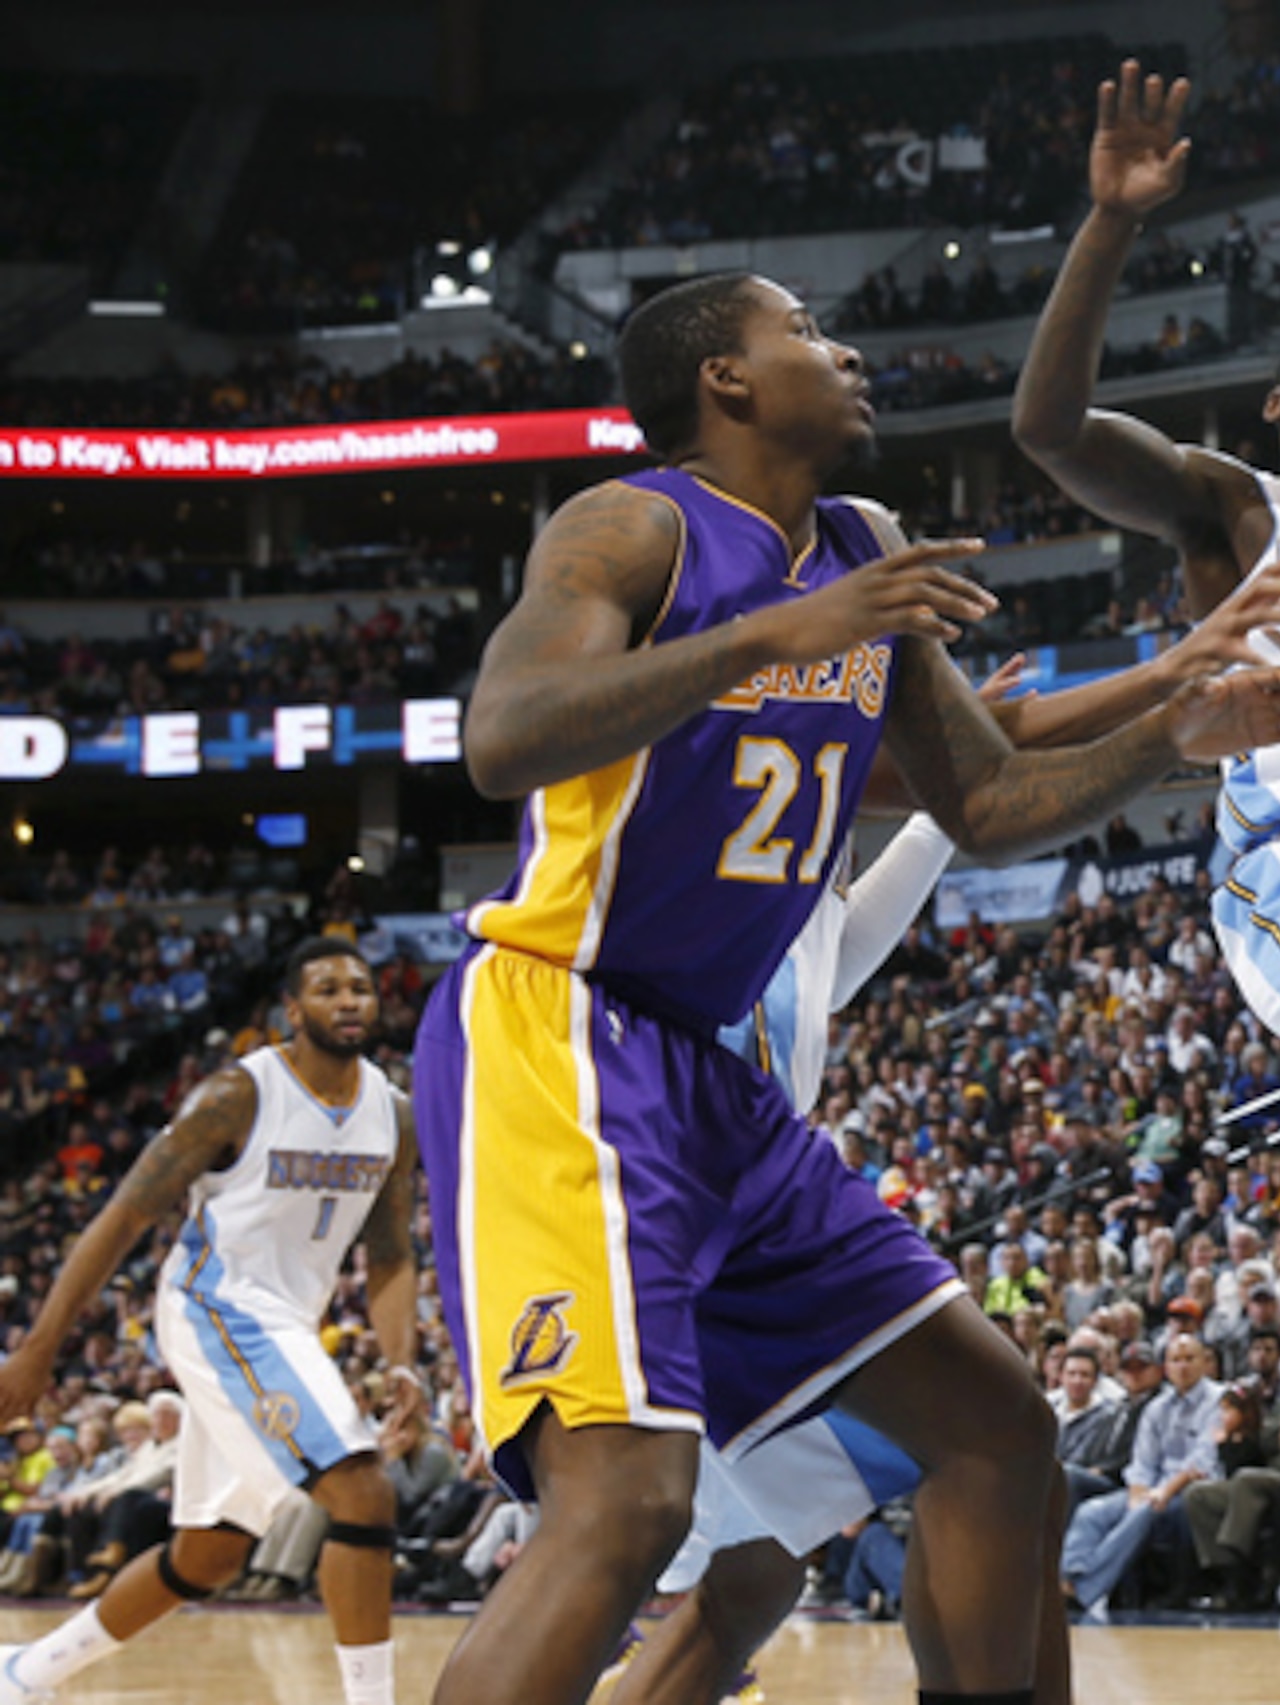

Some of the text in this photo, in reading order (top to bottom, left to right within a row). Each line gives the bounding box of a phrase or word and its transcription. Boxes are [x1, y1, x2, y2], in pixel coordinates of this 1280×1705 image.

[18, 436, 56, 467] to
[137, 437, 210, 469] Visit
[716, 734, 849, 884] 21
[311, 1197, 339, 1241] 1
